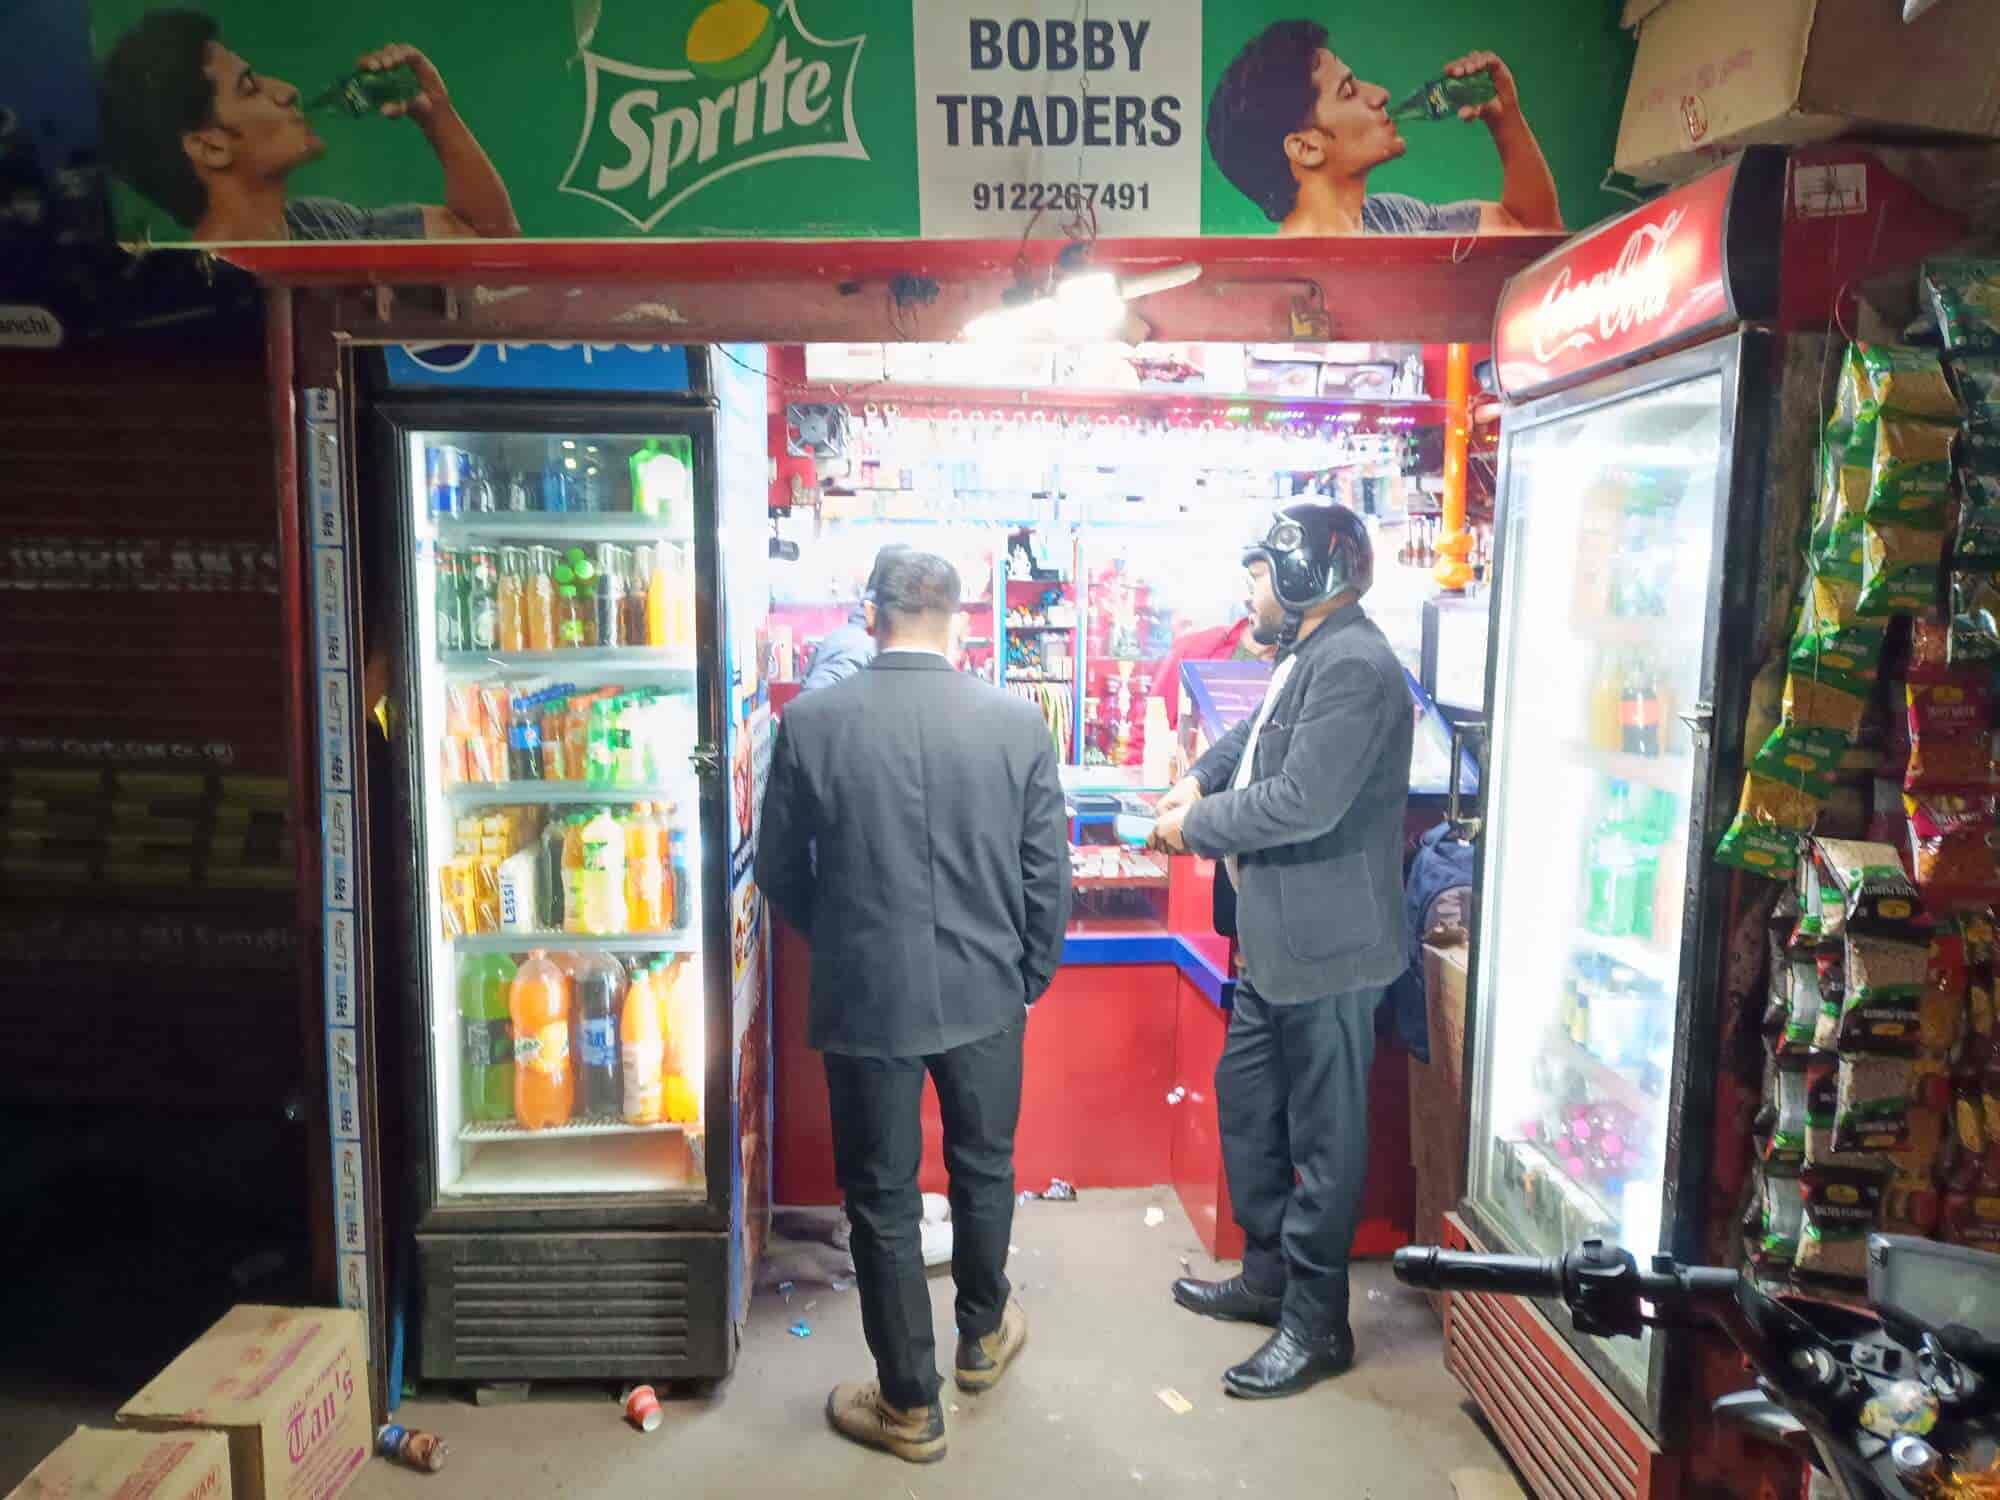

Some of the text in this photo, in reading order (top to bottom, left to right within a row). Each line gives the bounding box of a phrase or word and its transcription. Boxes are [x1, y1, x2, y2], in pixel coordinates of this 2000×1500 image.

[969, 18, 1151, 72] BOBBY
[597, 35, 832, 200] Sprite
[936, 94, 1182, 147] TRADERS
[973, 182, 1150, 211] 9122267491
